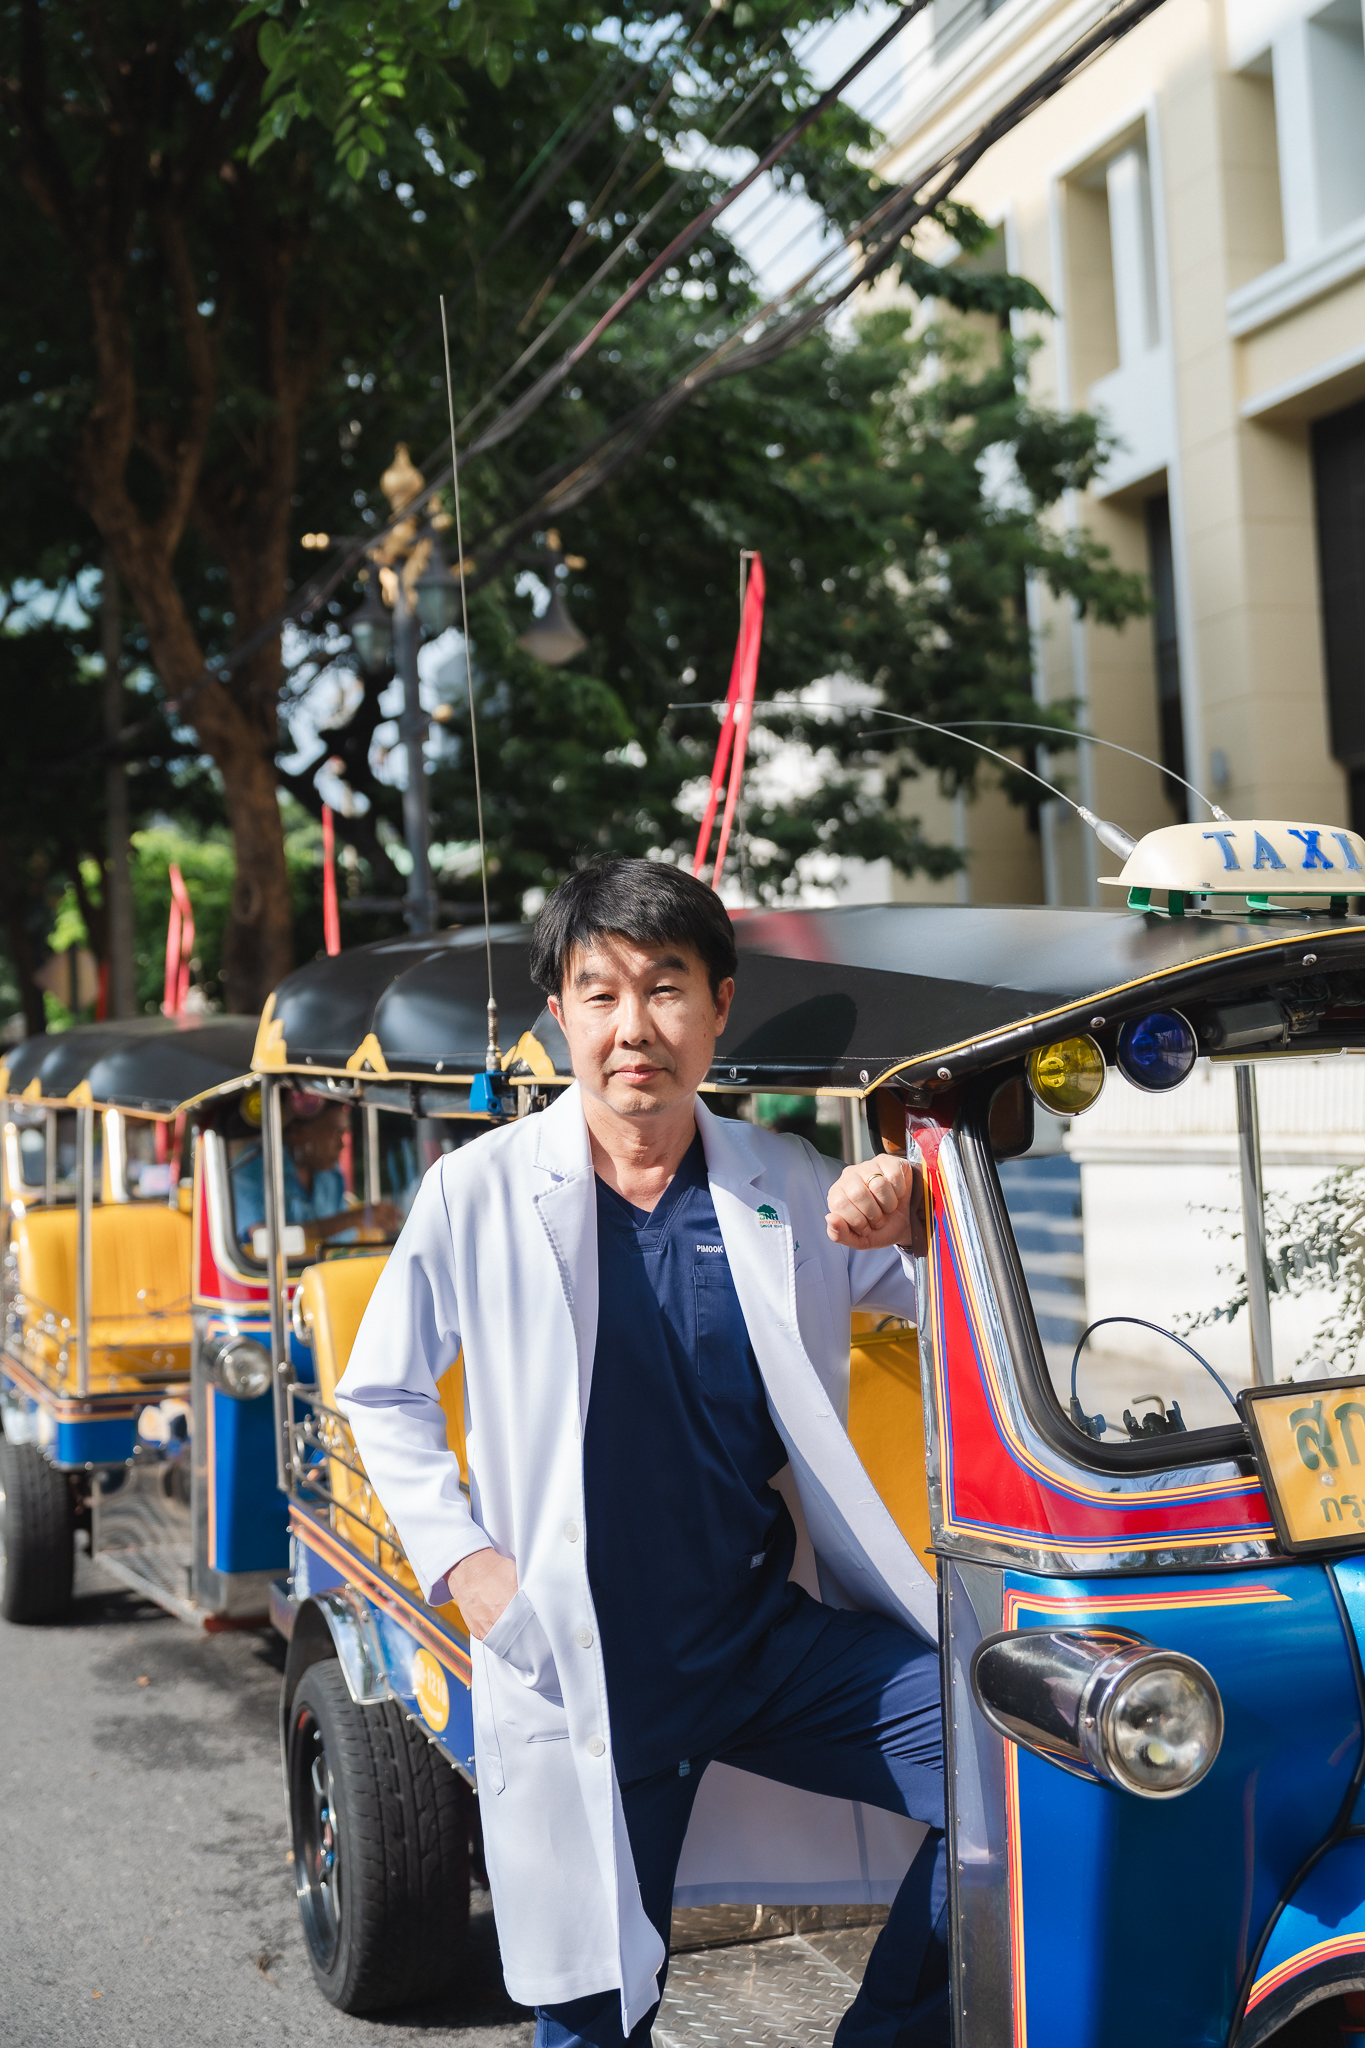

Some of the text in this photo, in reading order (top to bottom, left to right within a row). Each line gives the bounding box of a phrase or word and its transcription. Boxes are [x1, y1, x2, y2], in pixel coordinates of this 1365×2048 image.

[1202, 828, 1363, 870] TAXI
[696, 1244, 724, 1254] PIMOOK
[1319, 1494, 1365, 1529] กรุ
